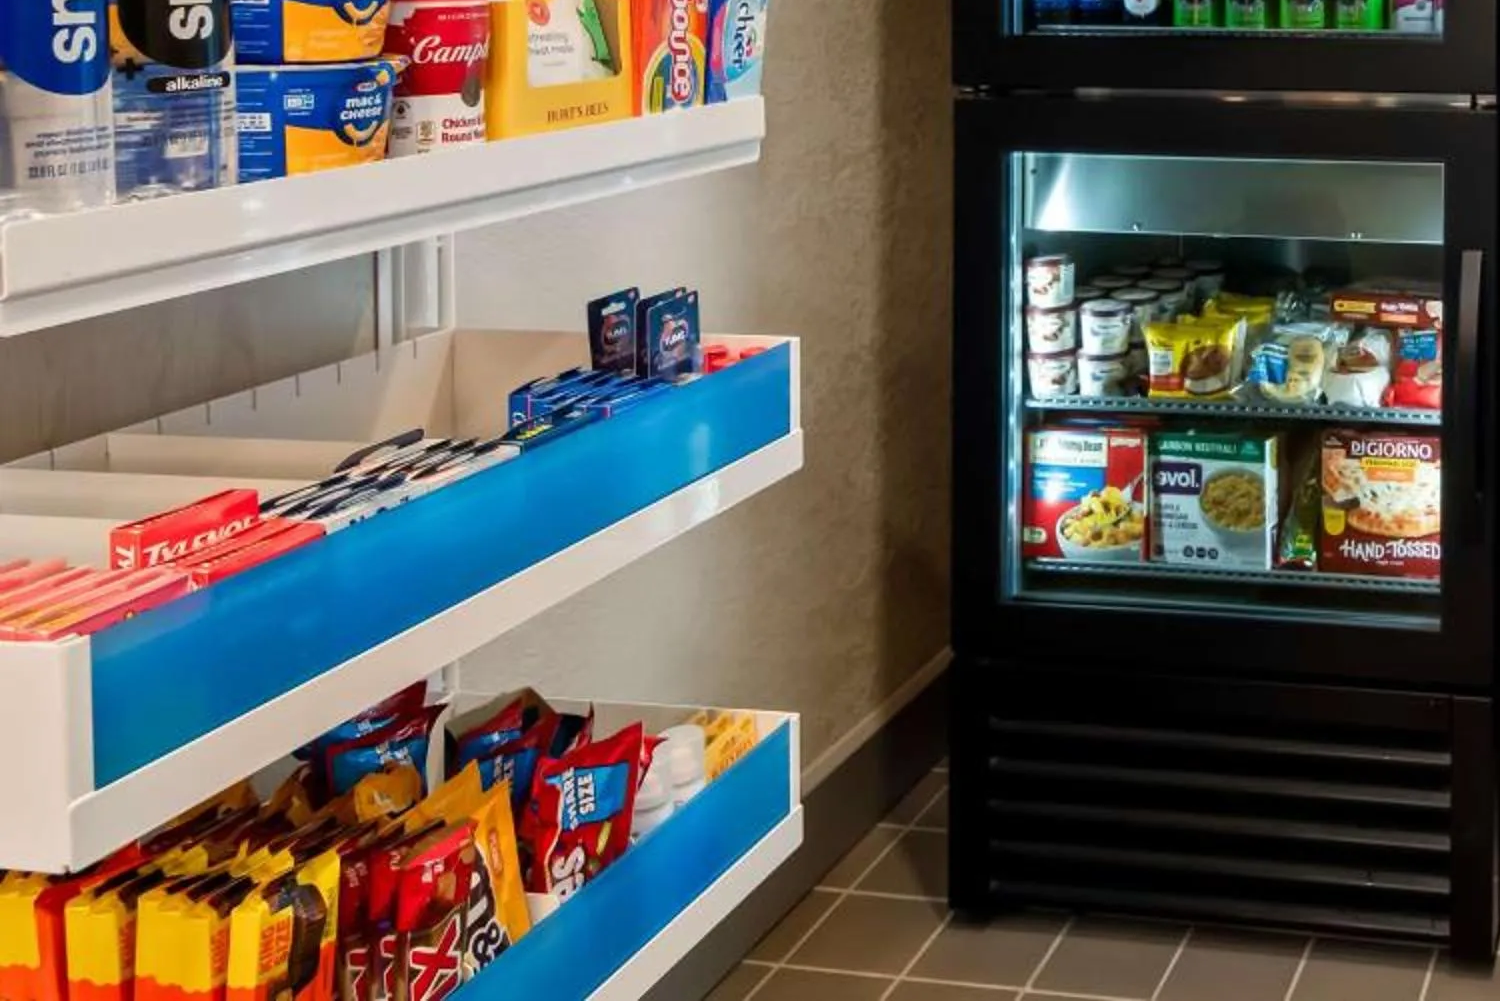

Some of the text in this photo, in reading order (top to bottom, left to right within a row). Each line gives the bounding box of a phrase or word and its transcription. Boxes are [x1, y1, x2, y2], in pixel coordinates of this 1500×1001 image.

[732, 1, 754, 71] cheer
[165, 72, 226, 93] alkaline
[547, 102, 609, 123] BURT'S BEES
[578, 772, 595, 814] SIZE
